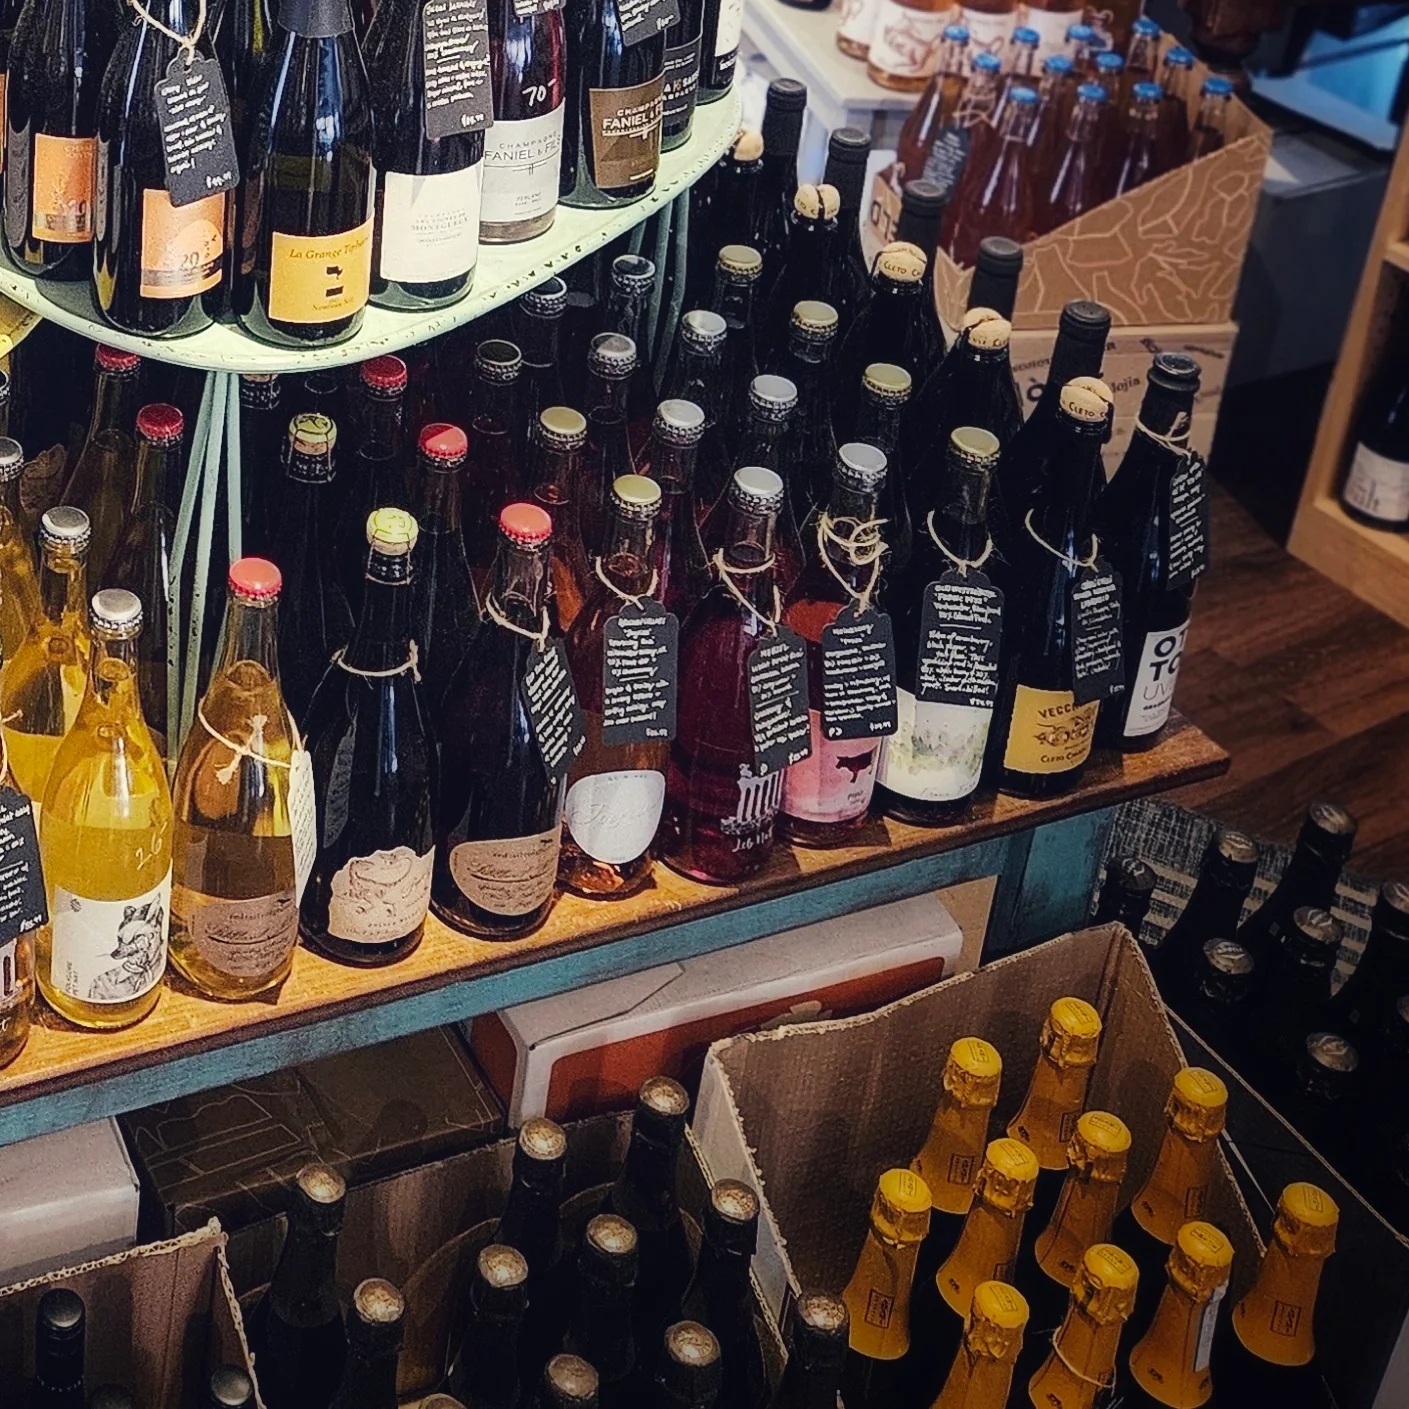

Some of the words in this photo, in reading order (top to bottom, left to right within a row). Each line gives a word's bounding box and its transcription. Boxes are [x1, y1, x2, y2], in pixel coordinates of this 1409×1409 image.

[602, 113, 648, 130] FANIEL
[484, 149, 535, 161] FANIEL
[180, 251, 200, 268] 20
[289, 248, 302, 258] La
[305, 248, 342, 260] Grange
[883, 259, 907, 274] CLETO
[1069, 401, 1095, 418] CLETO
